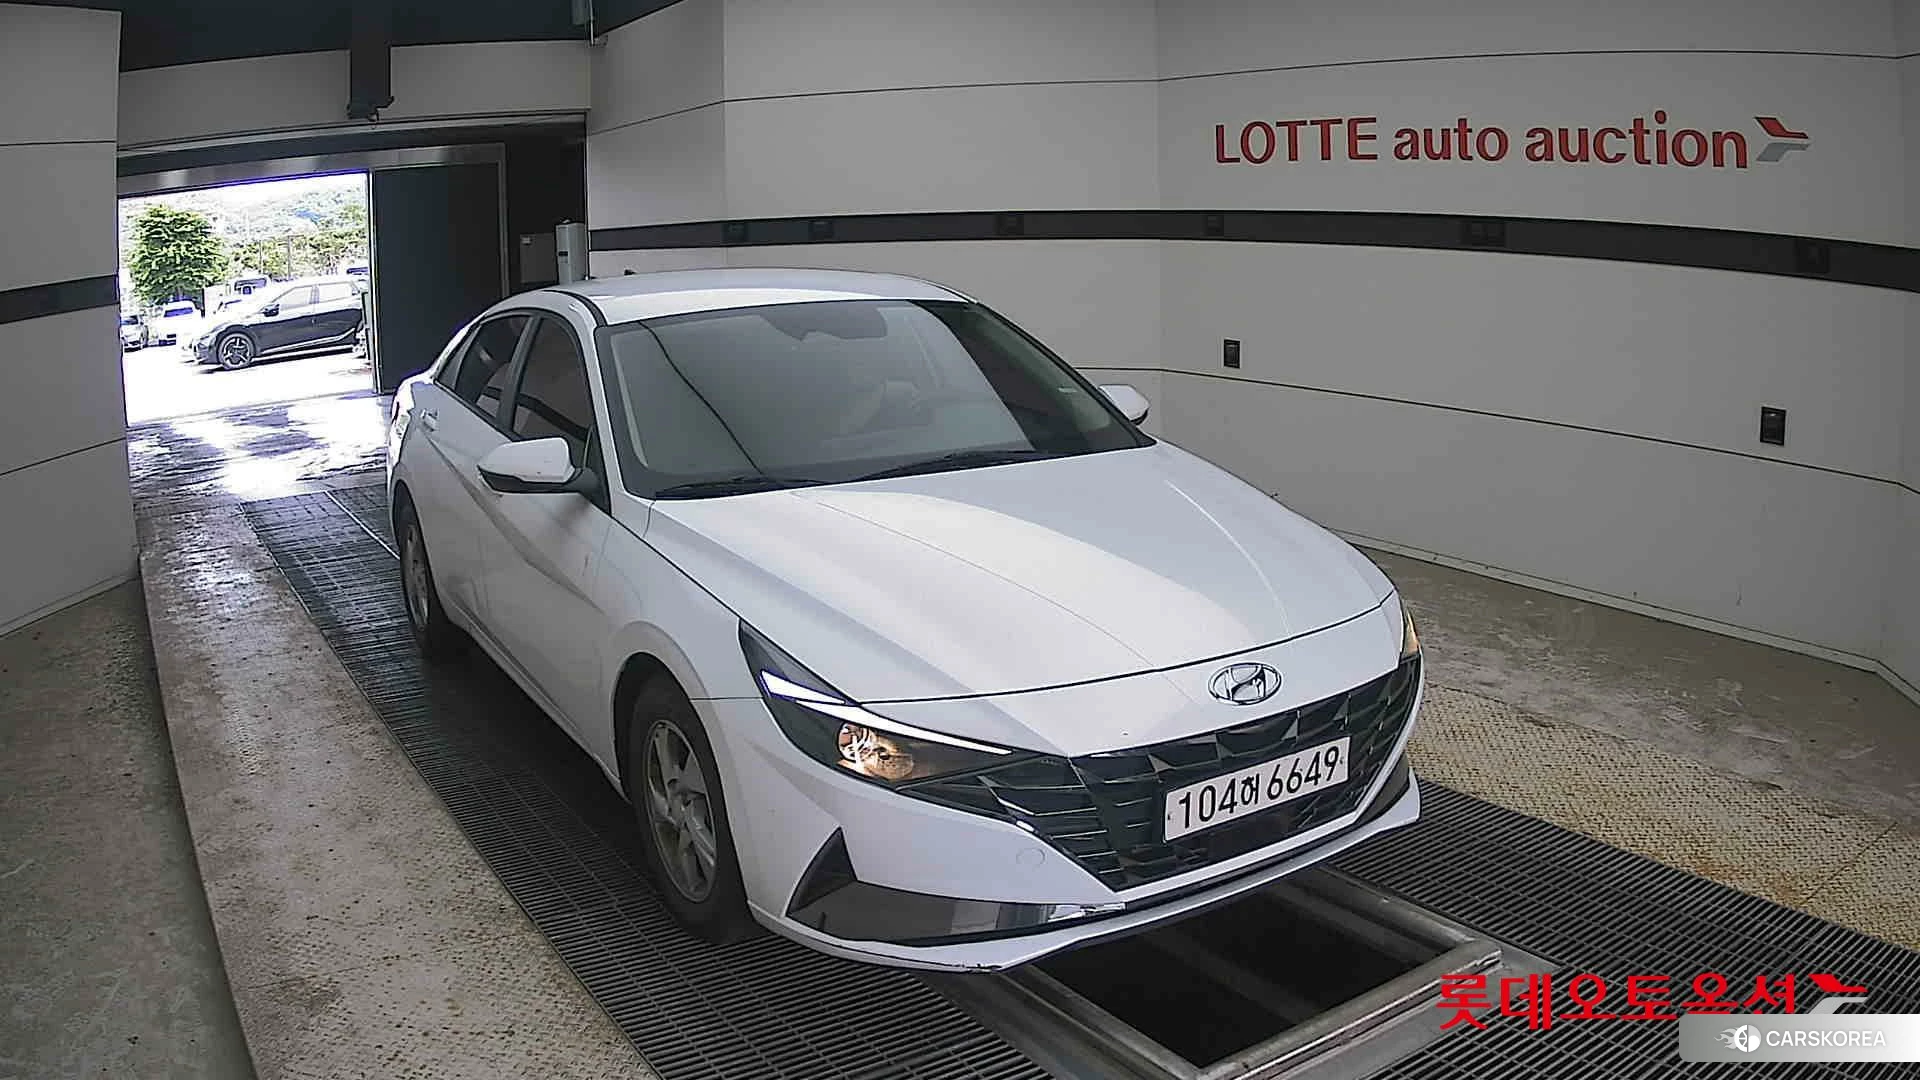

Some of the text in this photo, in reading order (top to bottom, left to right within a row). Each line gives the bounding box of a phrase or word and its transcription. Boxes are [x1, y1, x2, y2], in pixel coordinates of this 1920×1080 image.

[1215, 111, 1748, 169] LOTTE auto auction
